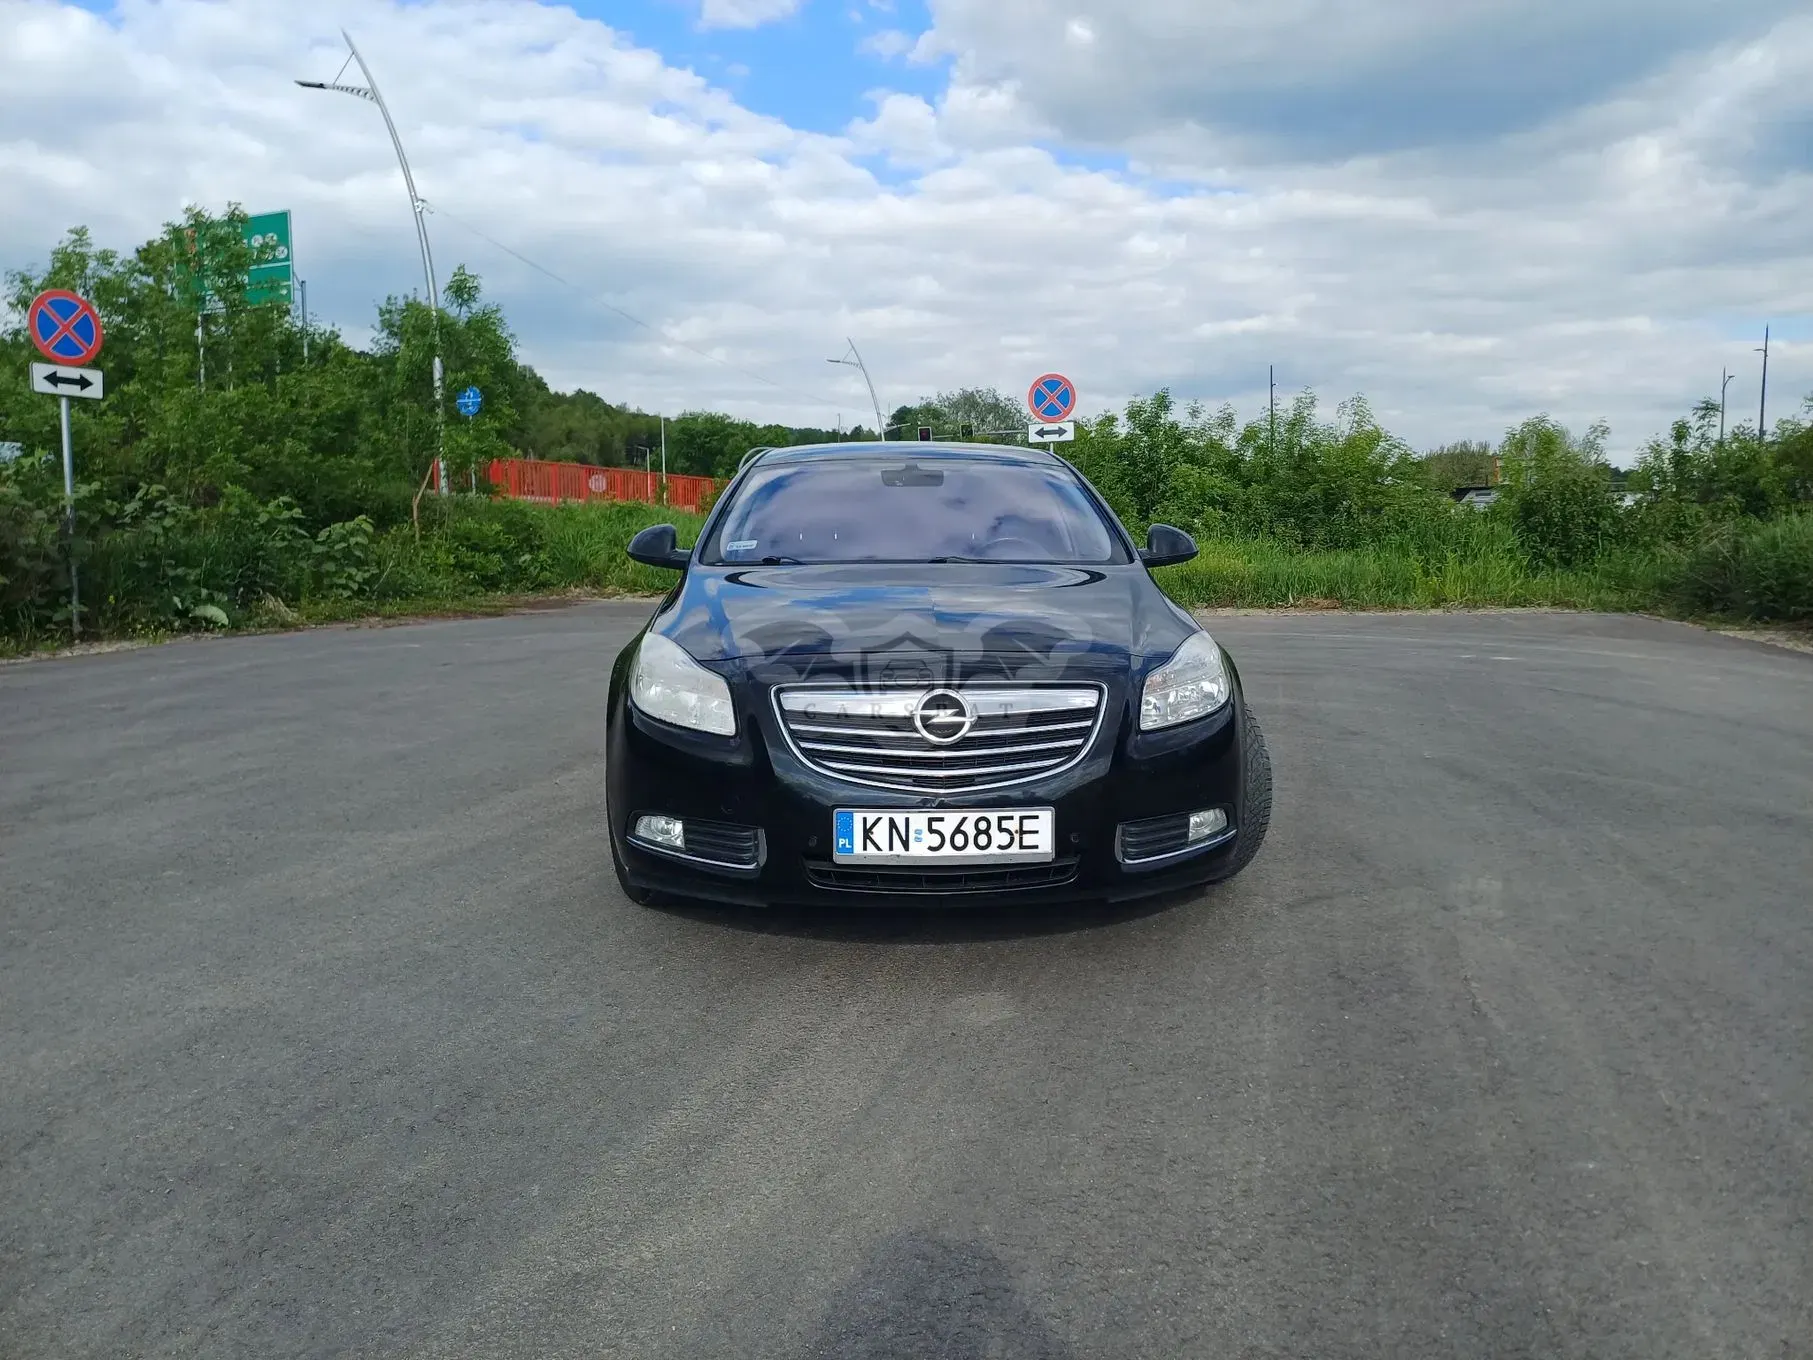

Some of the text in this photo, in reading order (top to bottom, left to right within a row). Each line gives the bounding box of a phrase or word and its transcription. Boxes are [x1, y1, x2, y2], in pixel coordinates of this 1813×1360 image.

[838, 838, 852, 849] PL
[862, 815, 1039, 852] KN 5685E
